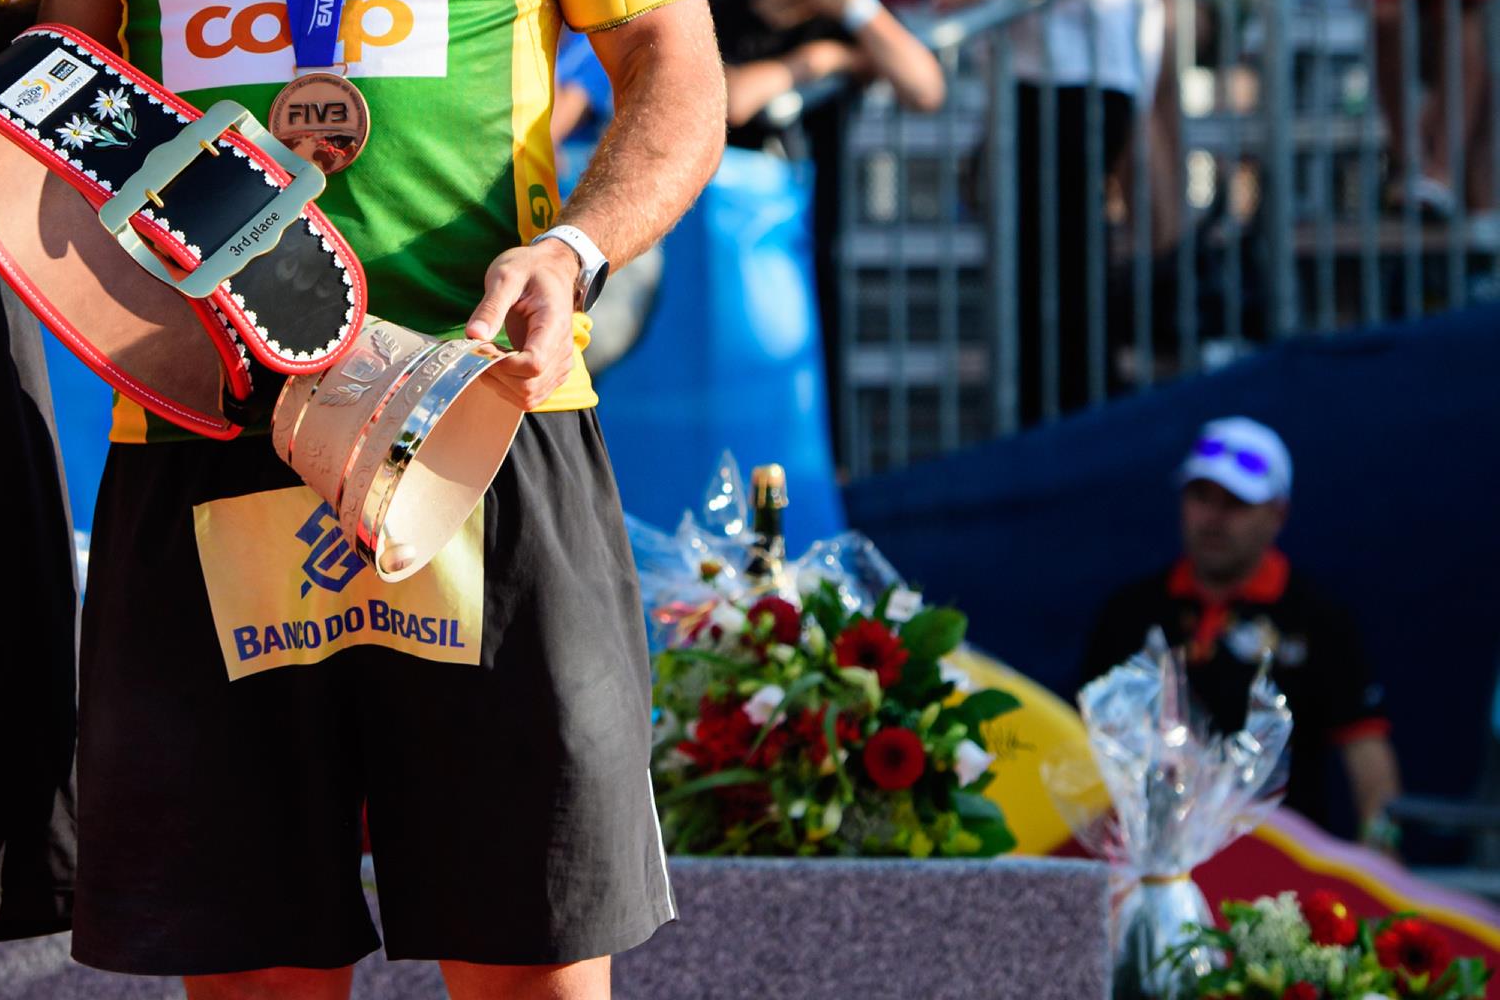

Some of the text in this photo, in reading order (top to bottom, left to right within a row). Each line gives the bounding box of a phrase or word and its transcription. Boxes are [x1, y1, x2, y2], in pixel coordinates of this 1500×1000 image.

[288, 102, 349, 126] FIVB
[229, 212, 280, 257] 3rd place
[233, 599, 465, 662] BANCO DO BRASIL
